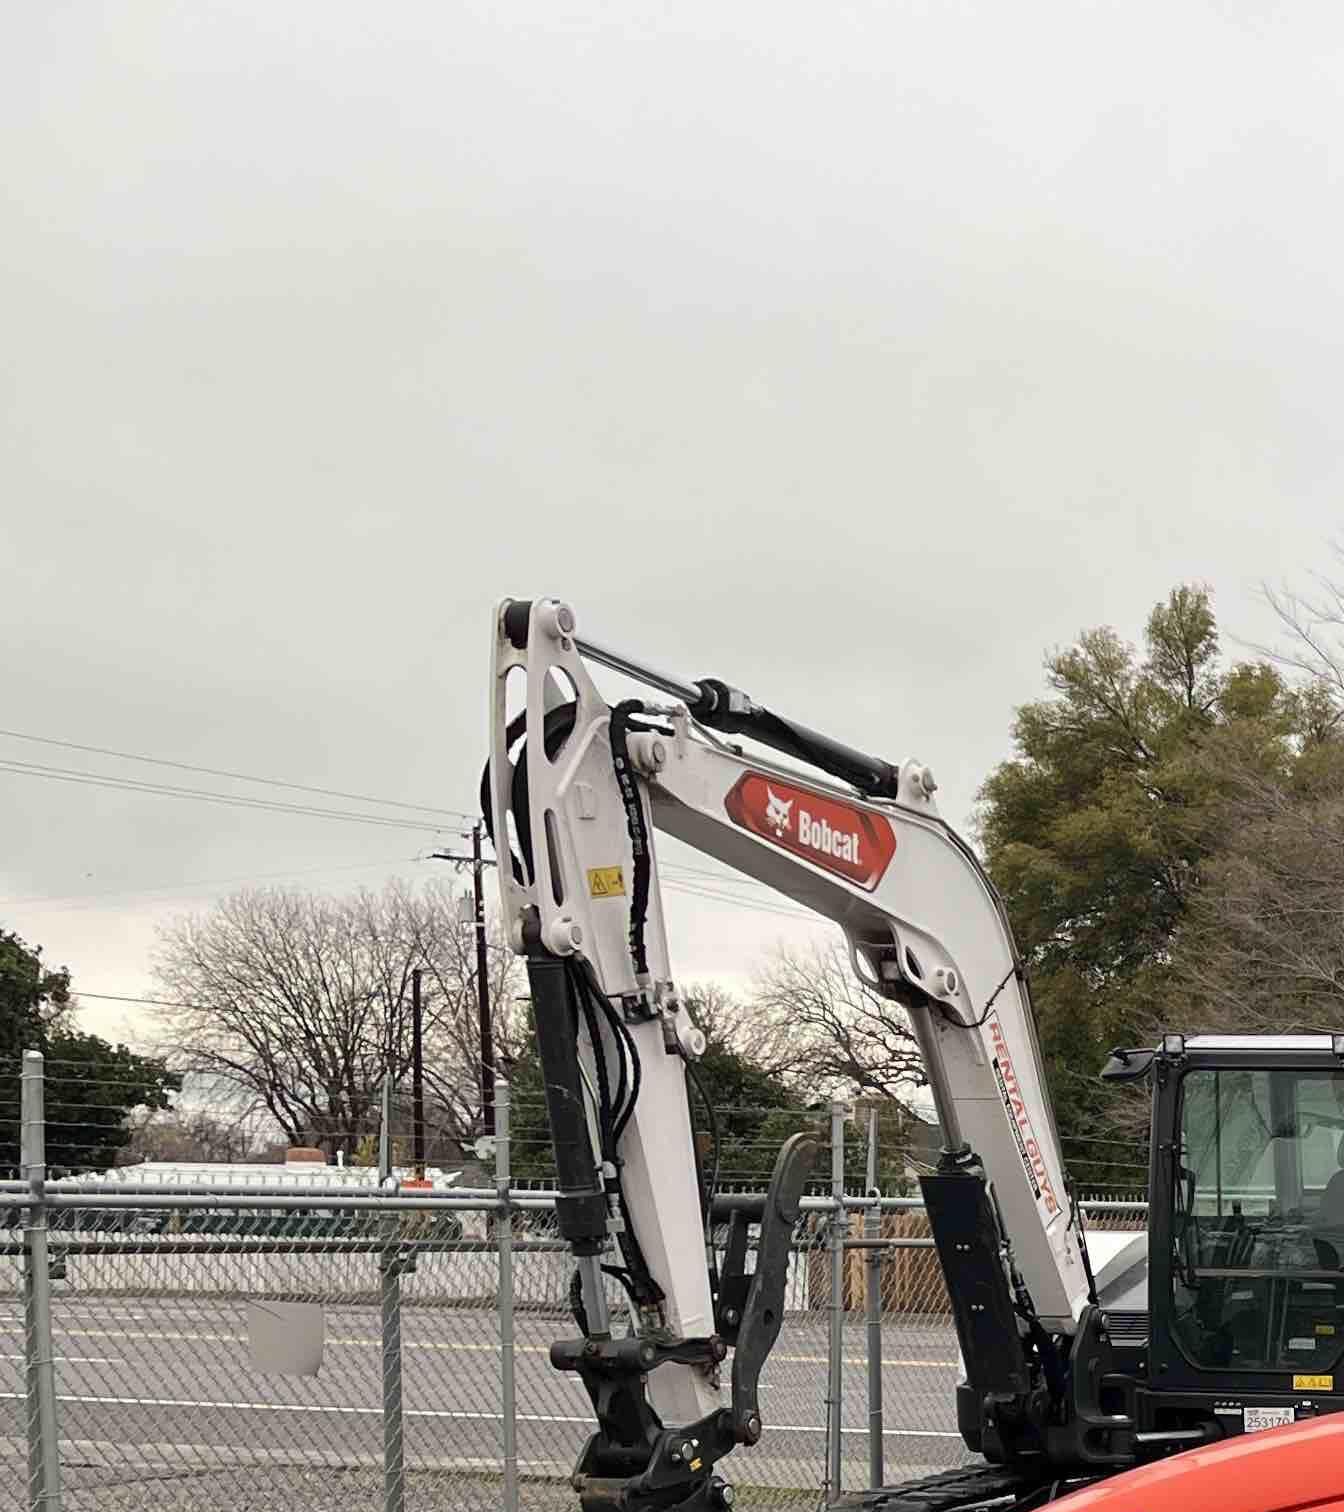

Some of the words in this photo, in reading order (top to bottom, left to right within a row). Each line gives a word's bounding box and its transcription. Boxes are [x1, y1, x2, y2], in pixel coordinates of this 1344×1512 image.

[798, 809, 860, 865] Bobcat
[989, 1022, 1028, 1132] RENTAL
[1026, 1137, 1057, 1215] GUYS
